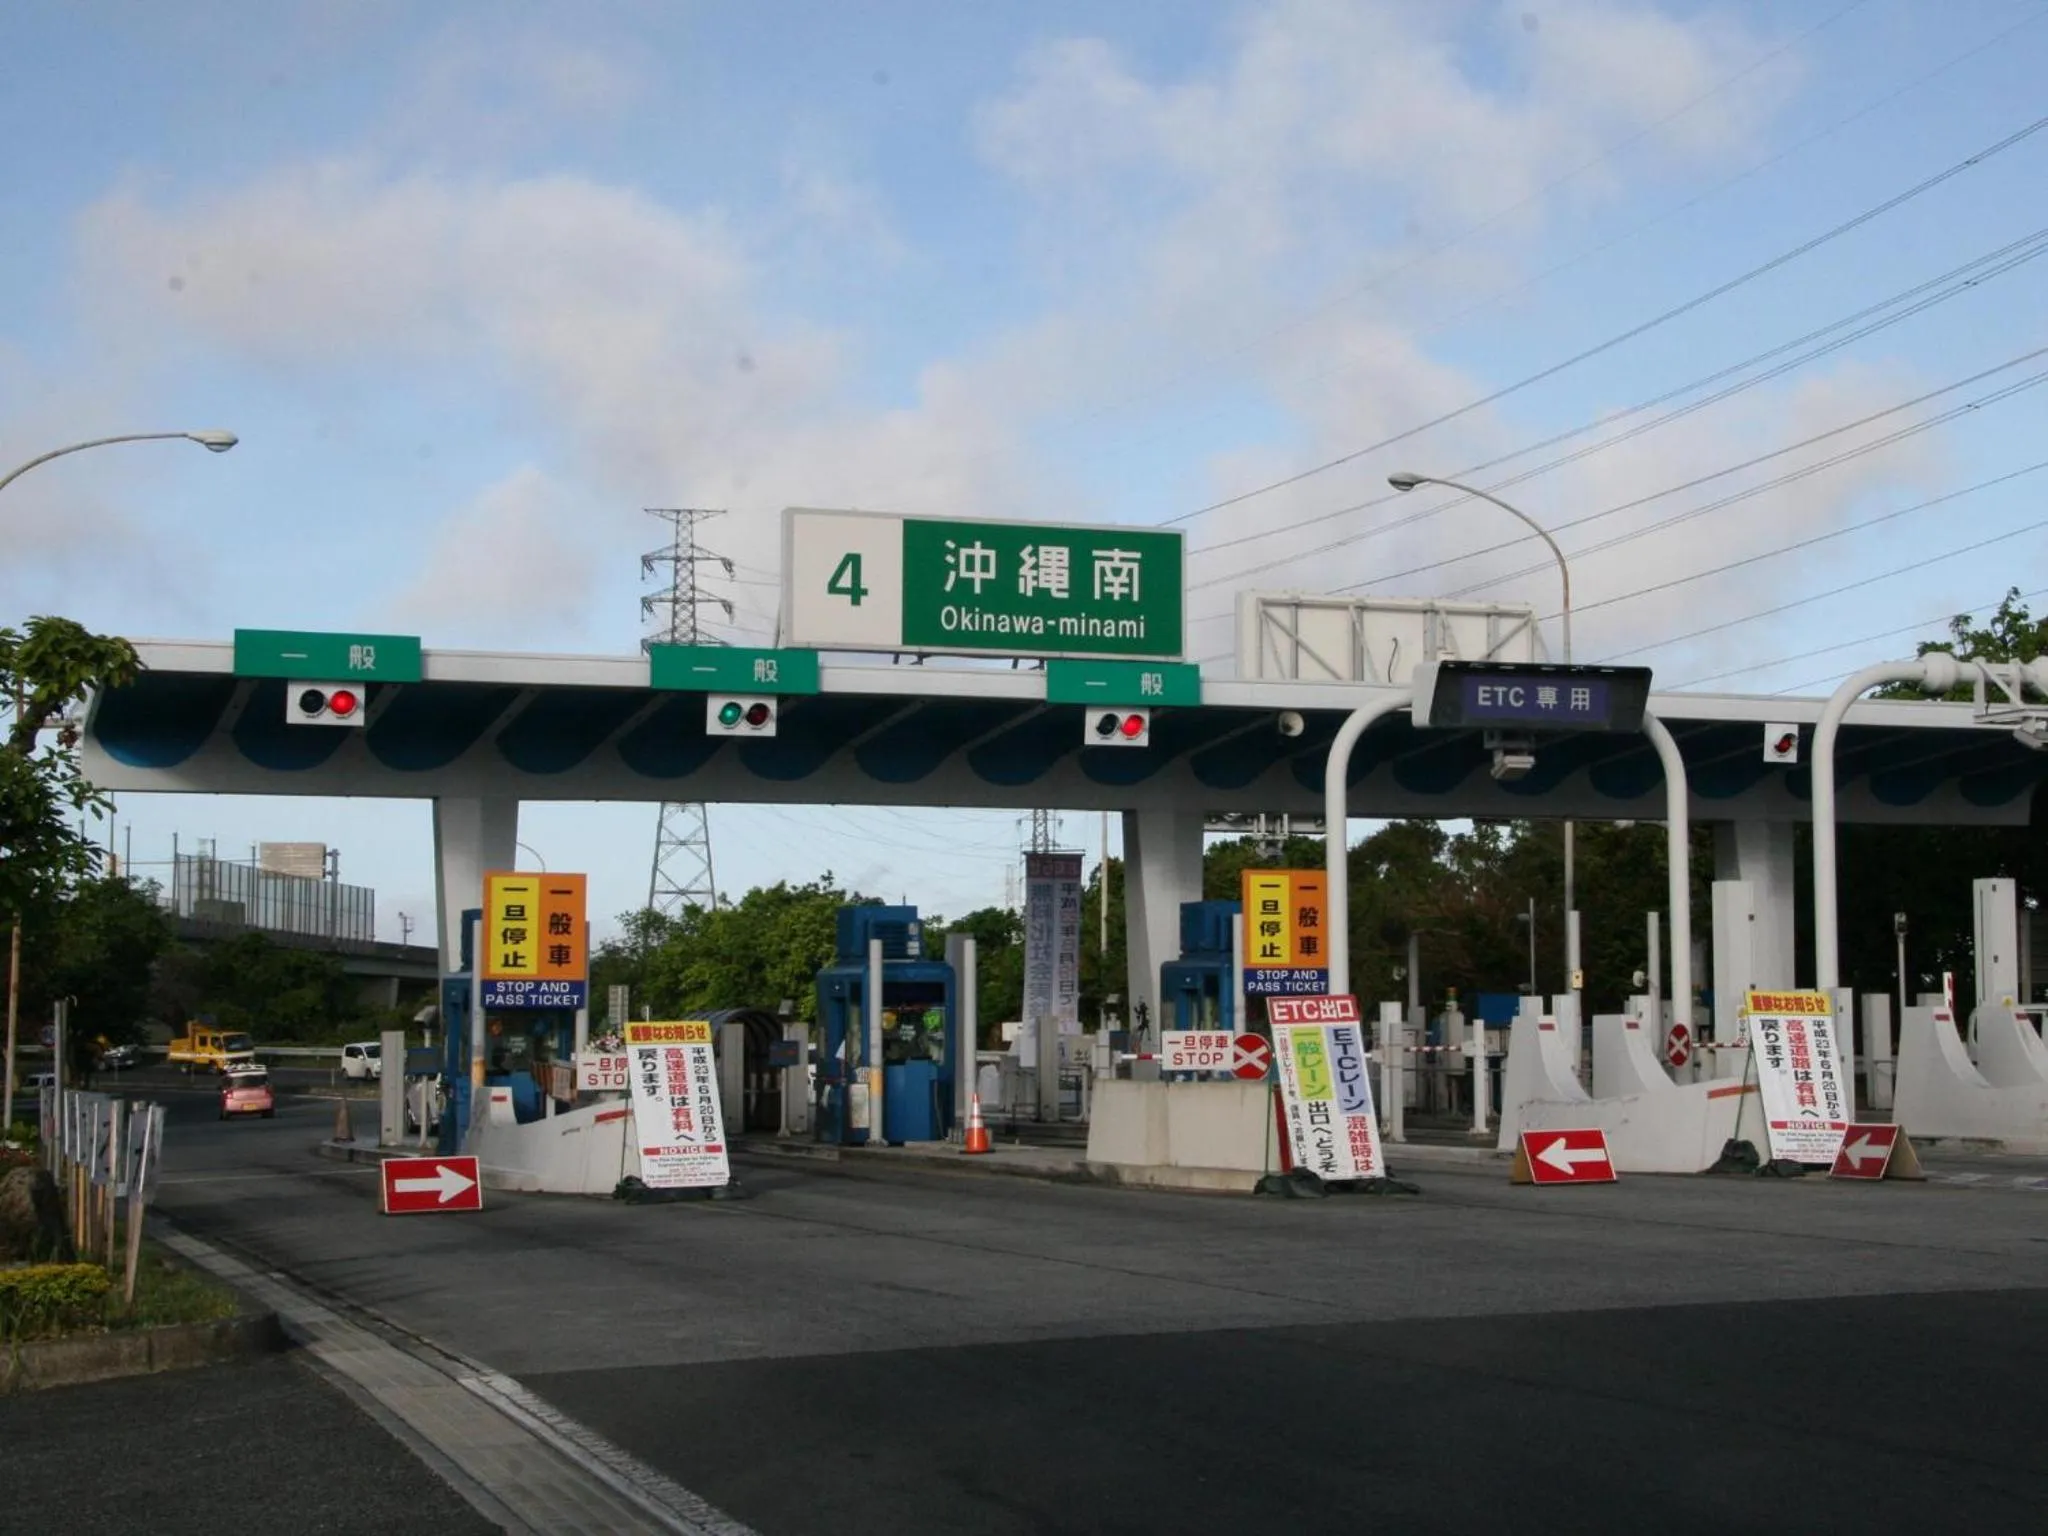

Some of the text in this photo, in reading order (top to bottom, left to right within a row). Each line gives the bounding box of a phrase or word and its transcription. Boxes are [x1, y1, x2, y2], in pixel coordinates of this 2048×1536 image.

[827, 553, 868, 606] 4
[944, 540, 1142, 602] 沖縄南
[940, 605, 1145, 638] Okinawa-minami
[1478, 685, 1590, 711] ETC 専用
[501, 887, 528, 968] 一旦停止
[548, 889, 573, 968] 一般車
[1259, 884, 1281, 958] 一旦停止
[1298, 885, 1319, 957] 一般車
[485, 994, 580, 1006] PASS TICKET
[496, 981, 570, 993] STOP AND
[1248, 981, 1326, 992] PASS TICKET
[1256, 970, 1318, 981] STOP AND
[1273, 999, 1354, 1021] ETC出口
[1168, 1035, 1229, 1050] 一旦停車
[1173, 1052, 1224, 1065] STOP
[1786, 1019, 1820, 1118] 高速道路は有料へ
[1812, 1019, 1840, 1119] 平成23年6月20日から
[664, 1048, 696, 1142] 高速道路は有料へ
[692, 1047, 716, 1142] 平成23年6月20日から
